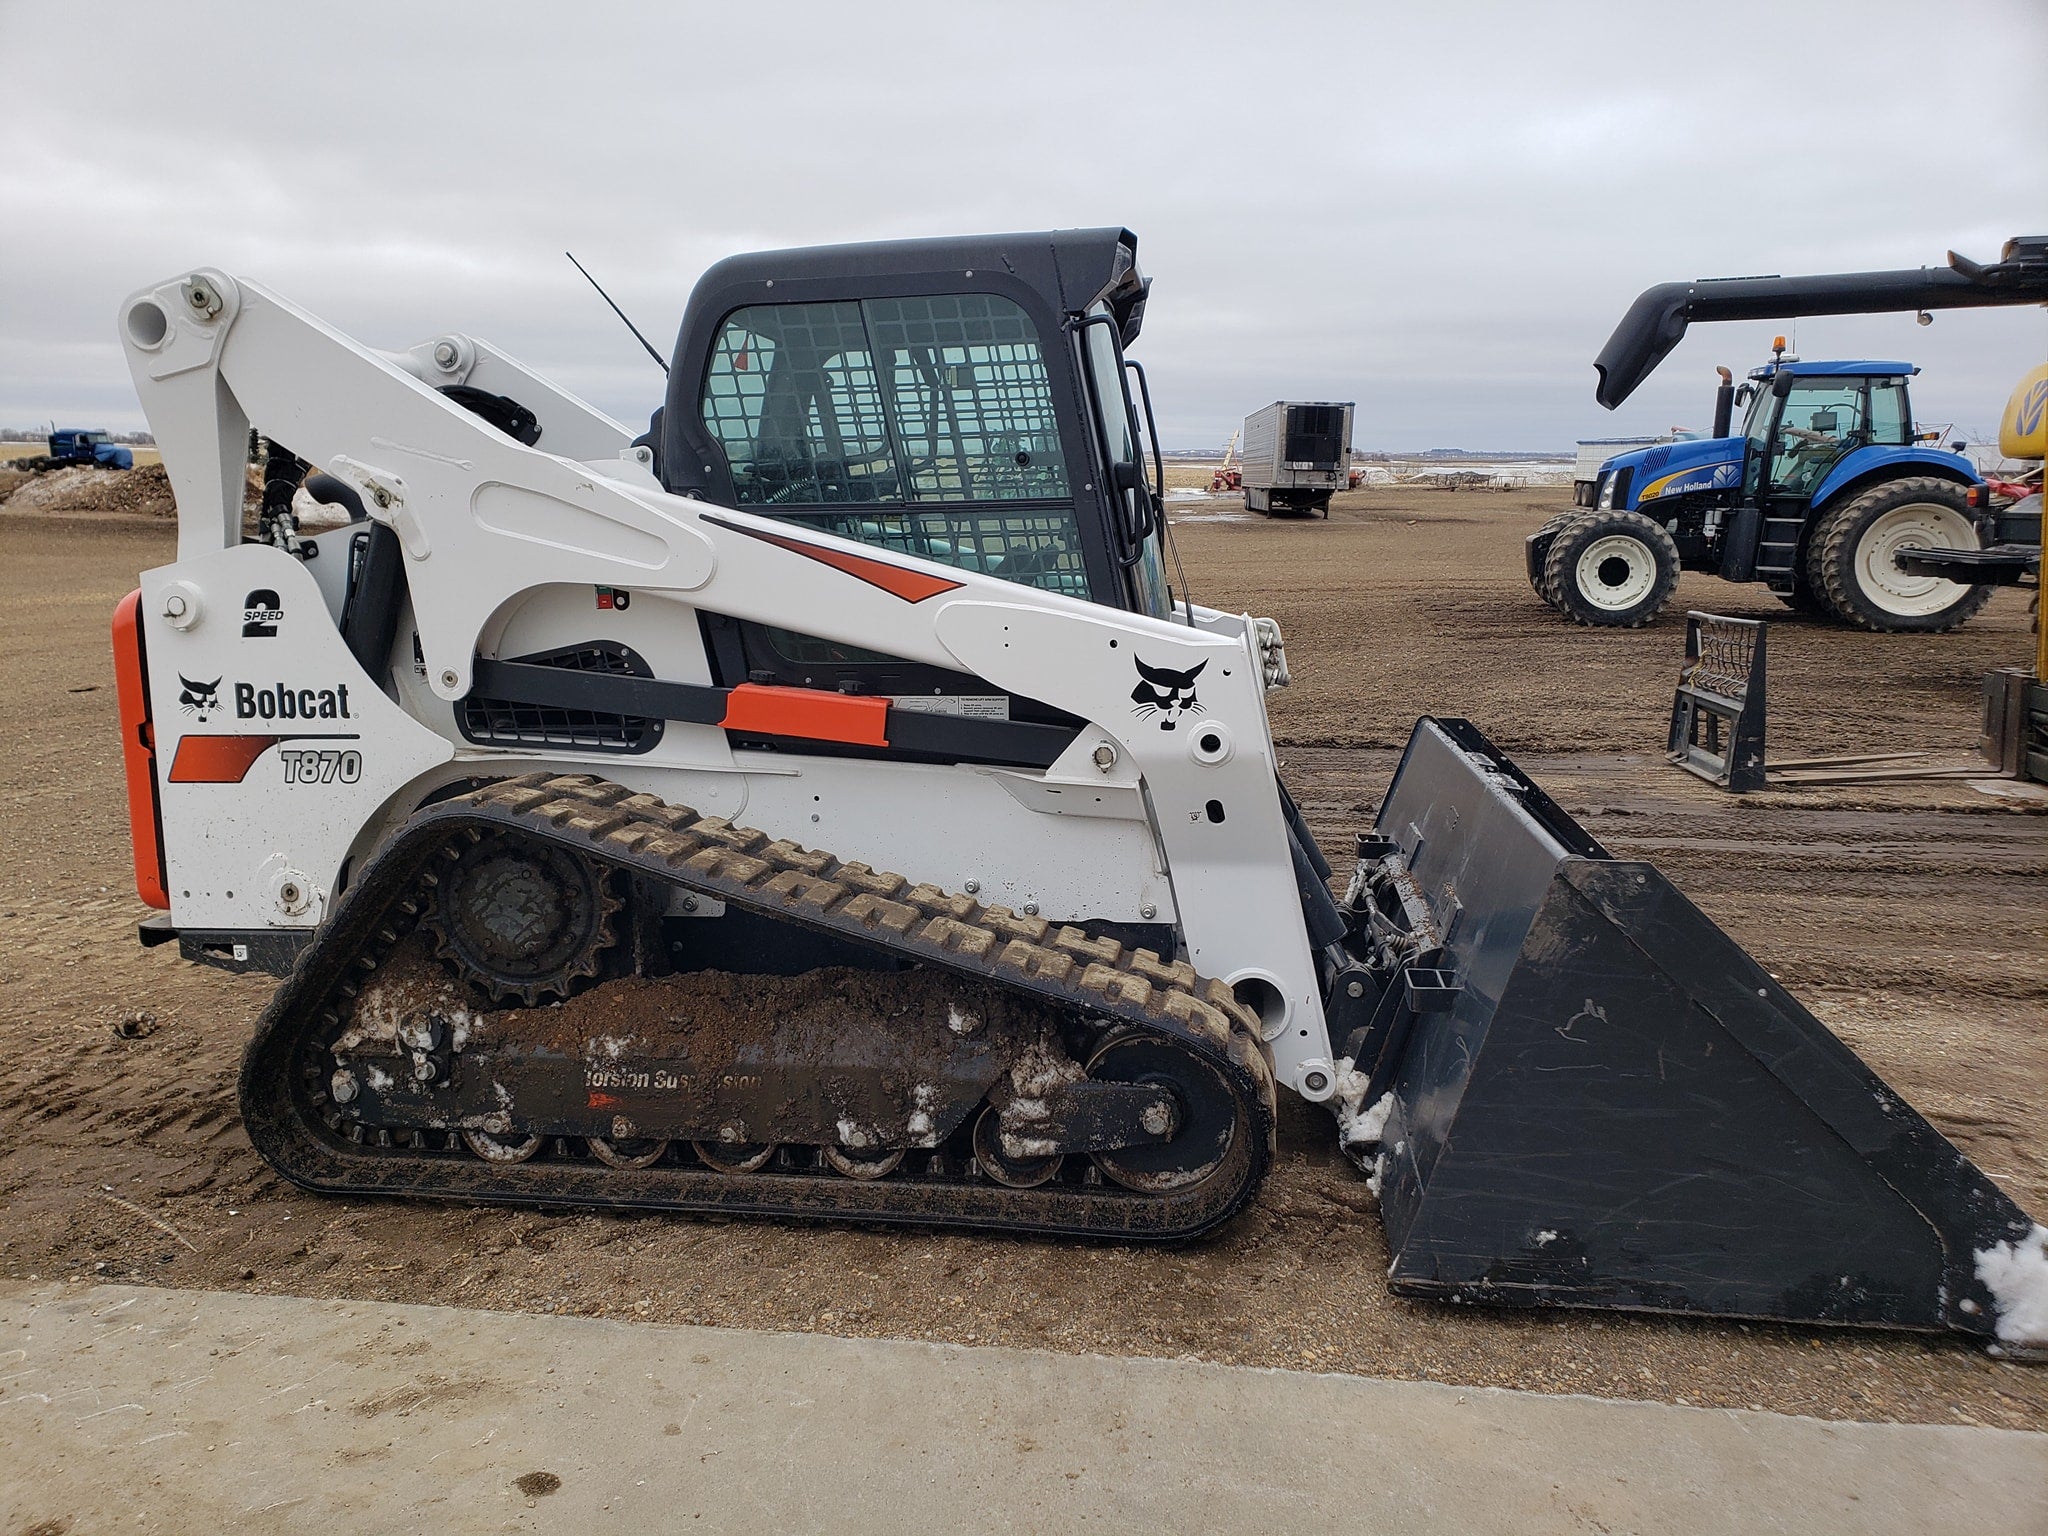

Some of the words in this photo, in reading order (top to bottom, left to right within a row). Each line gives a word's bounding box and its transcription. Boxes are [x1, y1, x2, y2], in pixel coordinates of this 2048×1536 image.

[1665, 486, 1682, 495] New
[1684, 480, 1712, 492] Holland
[242, 589, 280, 637] 2
[243, 611, 284, 621] SPEED
[234, 682, 350, 719] Bobcat
[281, 750, 362, 784] T870
